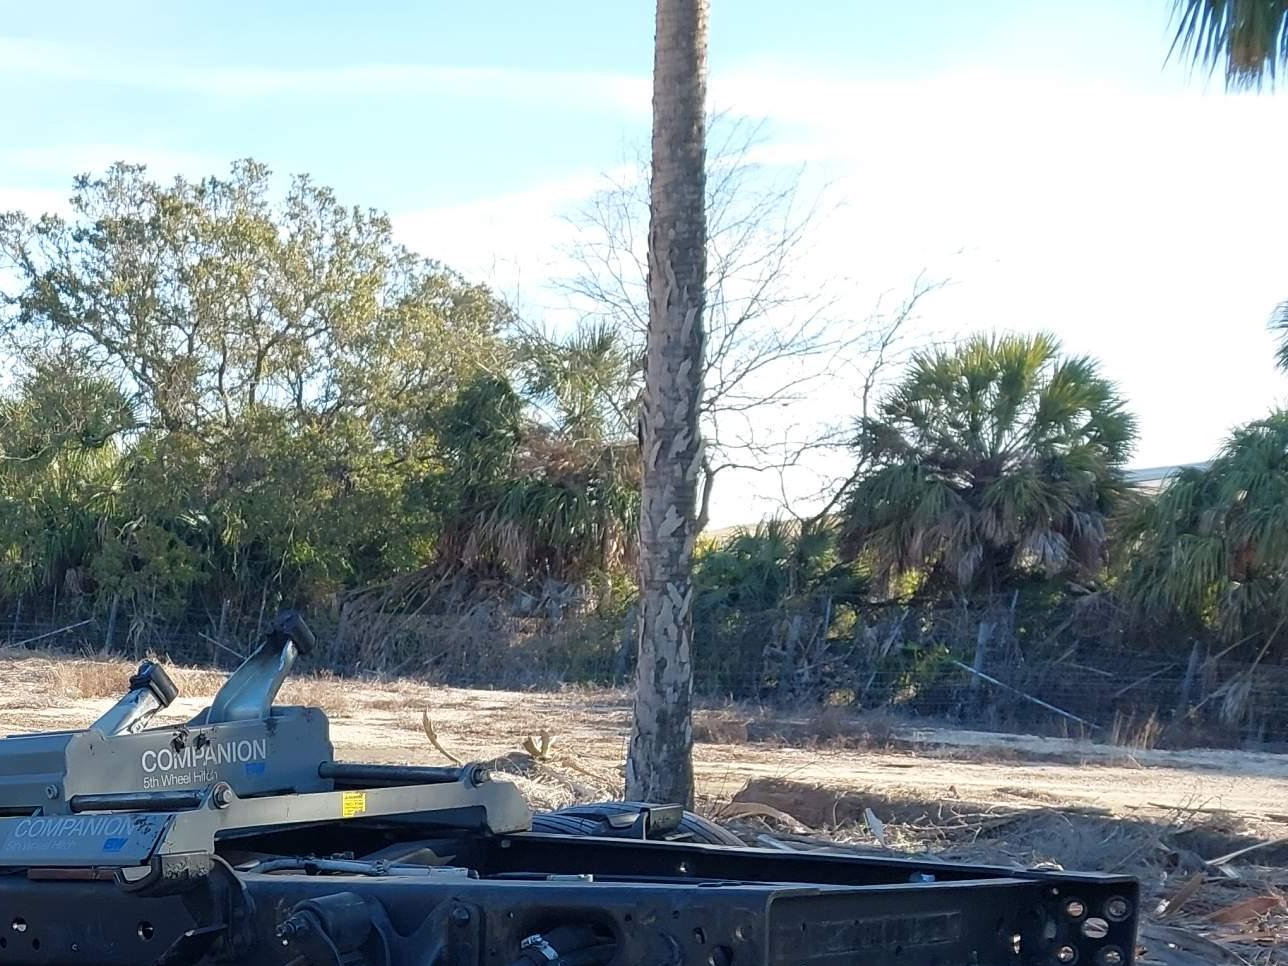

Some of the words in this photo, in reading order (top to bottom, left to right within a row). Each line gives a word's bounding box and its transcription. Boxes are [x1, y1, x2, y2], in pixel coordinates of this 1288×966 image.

[142, 739, 266, 773] COMPANION
[143, 776, 160, 789] 5th
[161, 773, 191, 787] Wheel
[14, 816, 136, 838] COMPANION
